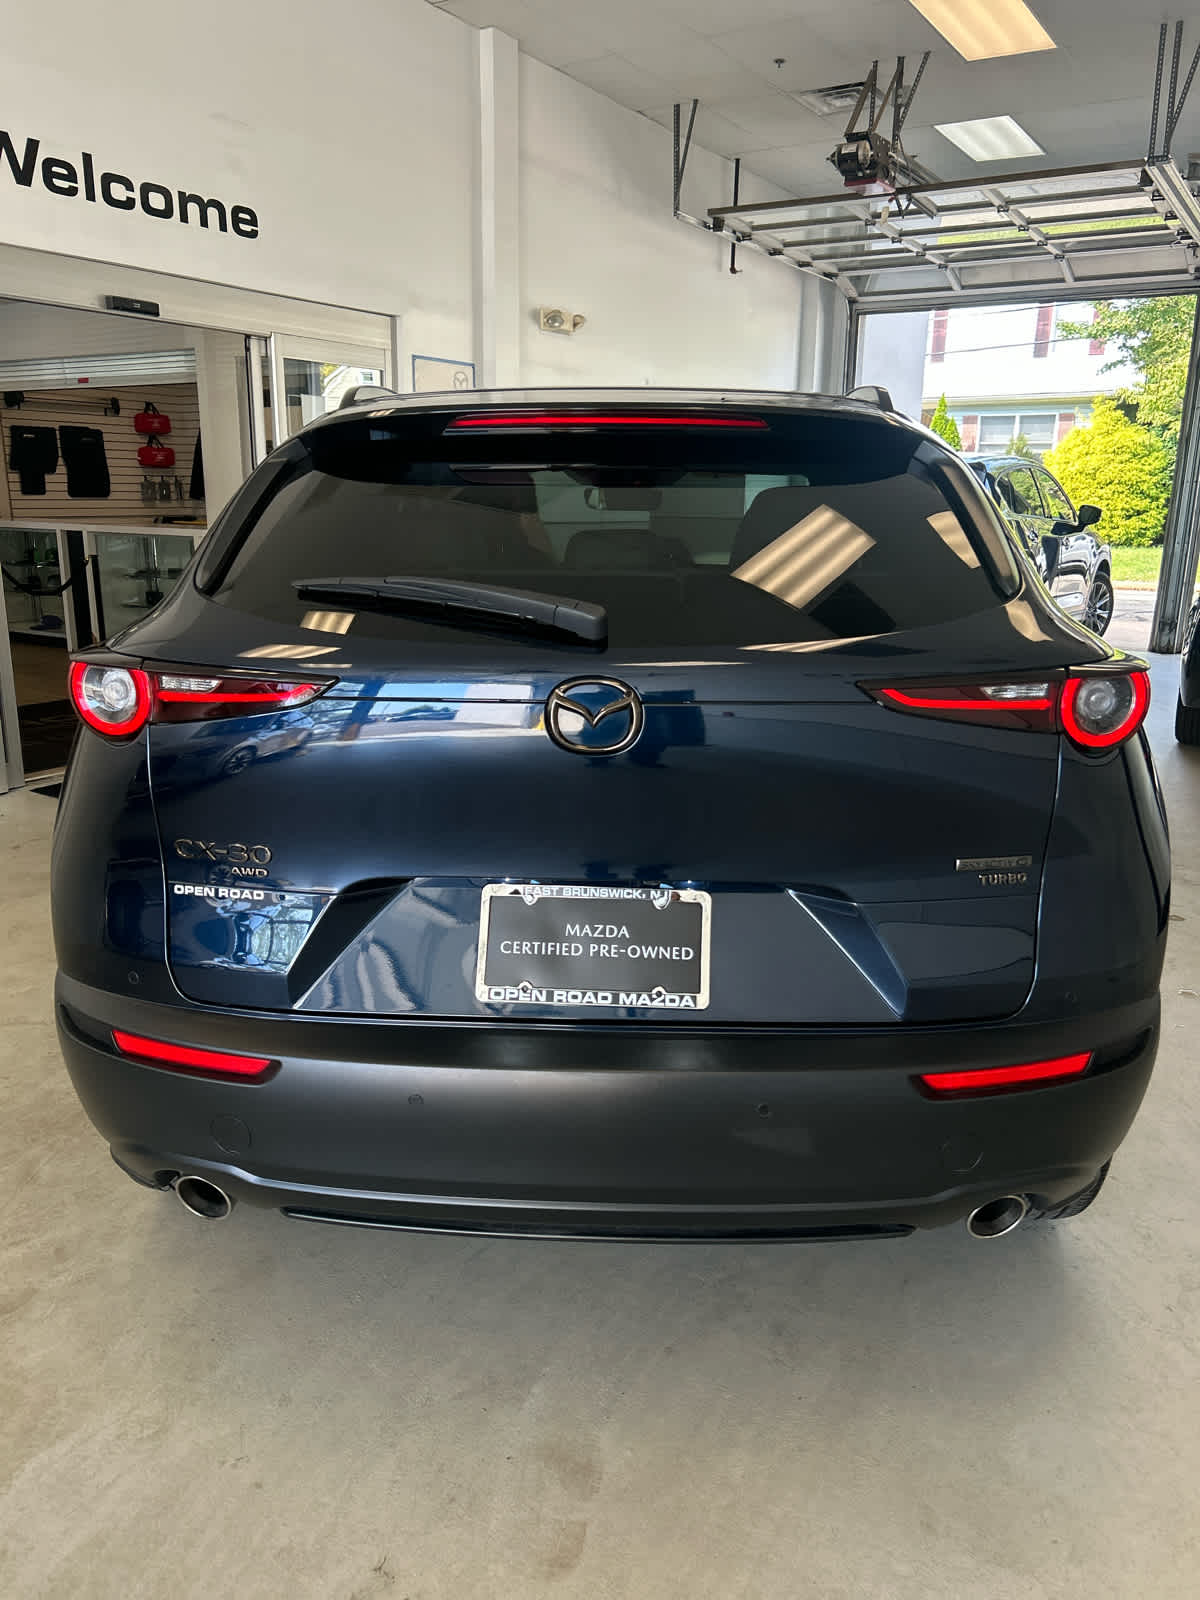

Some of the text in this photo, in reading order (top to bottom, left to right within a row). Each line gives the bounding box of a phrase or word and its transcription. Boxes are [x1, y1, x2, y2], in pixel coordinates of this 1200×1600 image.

[174, 839, 272, 865] CX-30
[231, 866, 268, 878] AWD
[978, 872, 1027, 886] TURBO
[173, 884, 265, 901] OPEN ROAD
[525, 886, 560, 897] EAST
[562, 887, 646, 899] BRUNSWICK,
[565, 923, 630, 939] MAZDA
[500, 940, 694, 961] CERTIFIED PRE-OWNED
[489, 988, 547, 1002] OPEN
[553, 990, 612, 1005] ROAD
